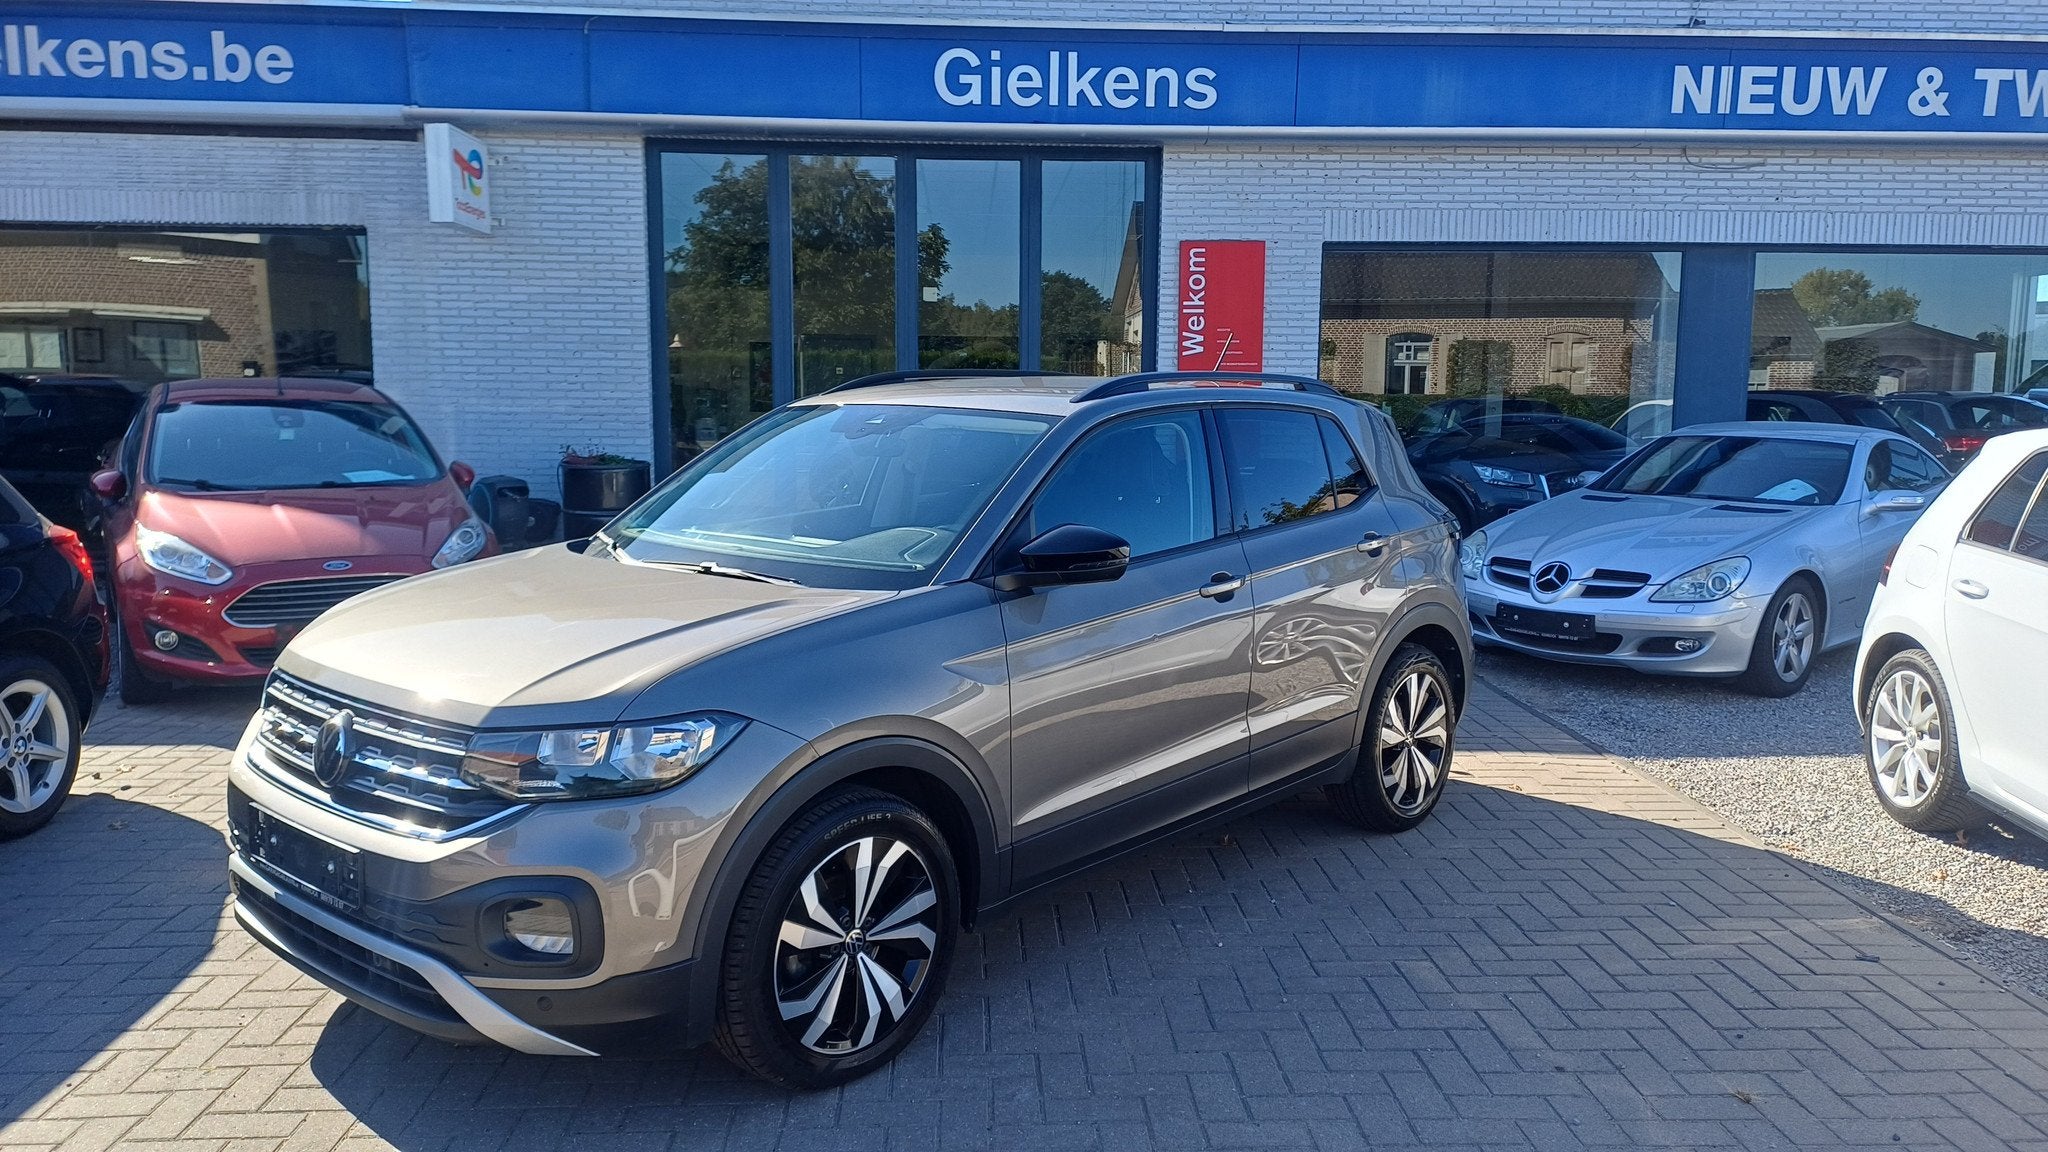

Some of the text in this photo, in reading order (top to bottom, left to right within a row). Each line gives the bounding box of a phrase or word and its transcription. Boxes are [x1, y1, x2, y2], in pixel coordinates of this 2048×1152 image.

[0, 24, 294, 84] lkens.be
[933, 47, 1218, 110] Gielkens
[1670, 65, 1888, 116] NIEUW
[1907, 66, 1950, 117] &
[1182, 247, 1206, 356] Welkom
